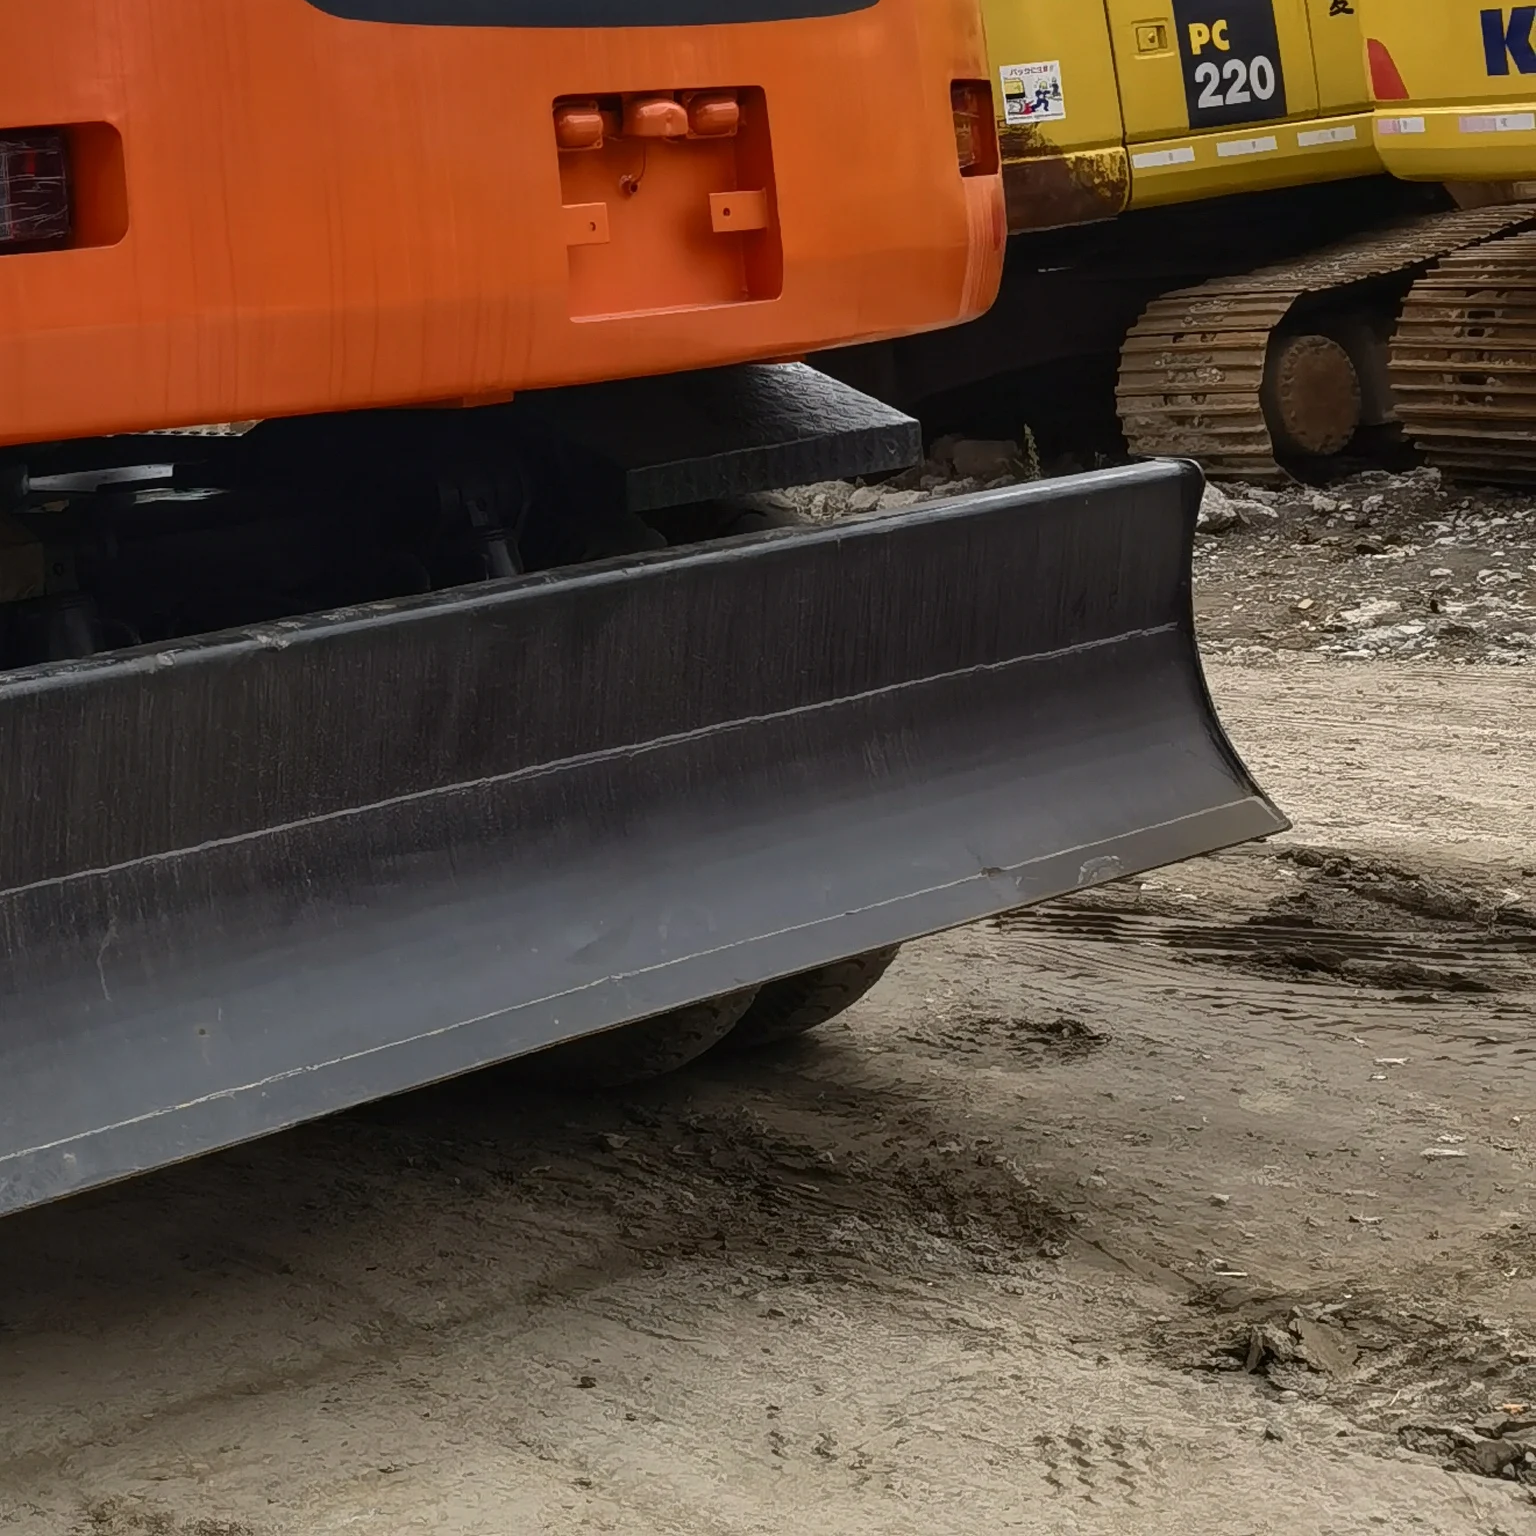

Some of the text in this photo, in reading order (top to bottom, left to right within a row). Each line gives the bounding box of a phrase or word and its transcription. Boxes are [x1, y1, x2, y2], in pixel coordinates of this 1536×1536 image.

[1188, 19, 1230, 55] PC
[1480, 5, 1536, 76] K
[1194, 55, 1275, 109] 220
